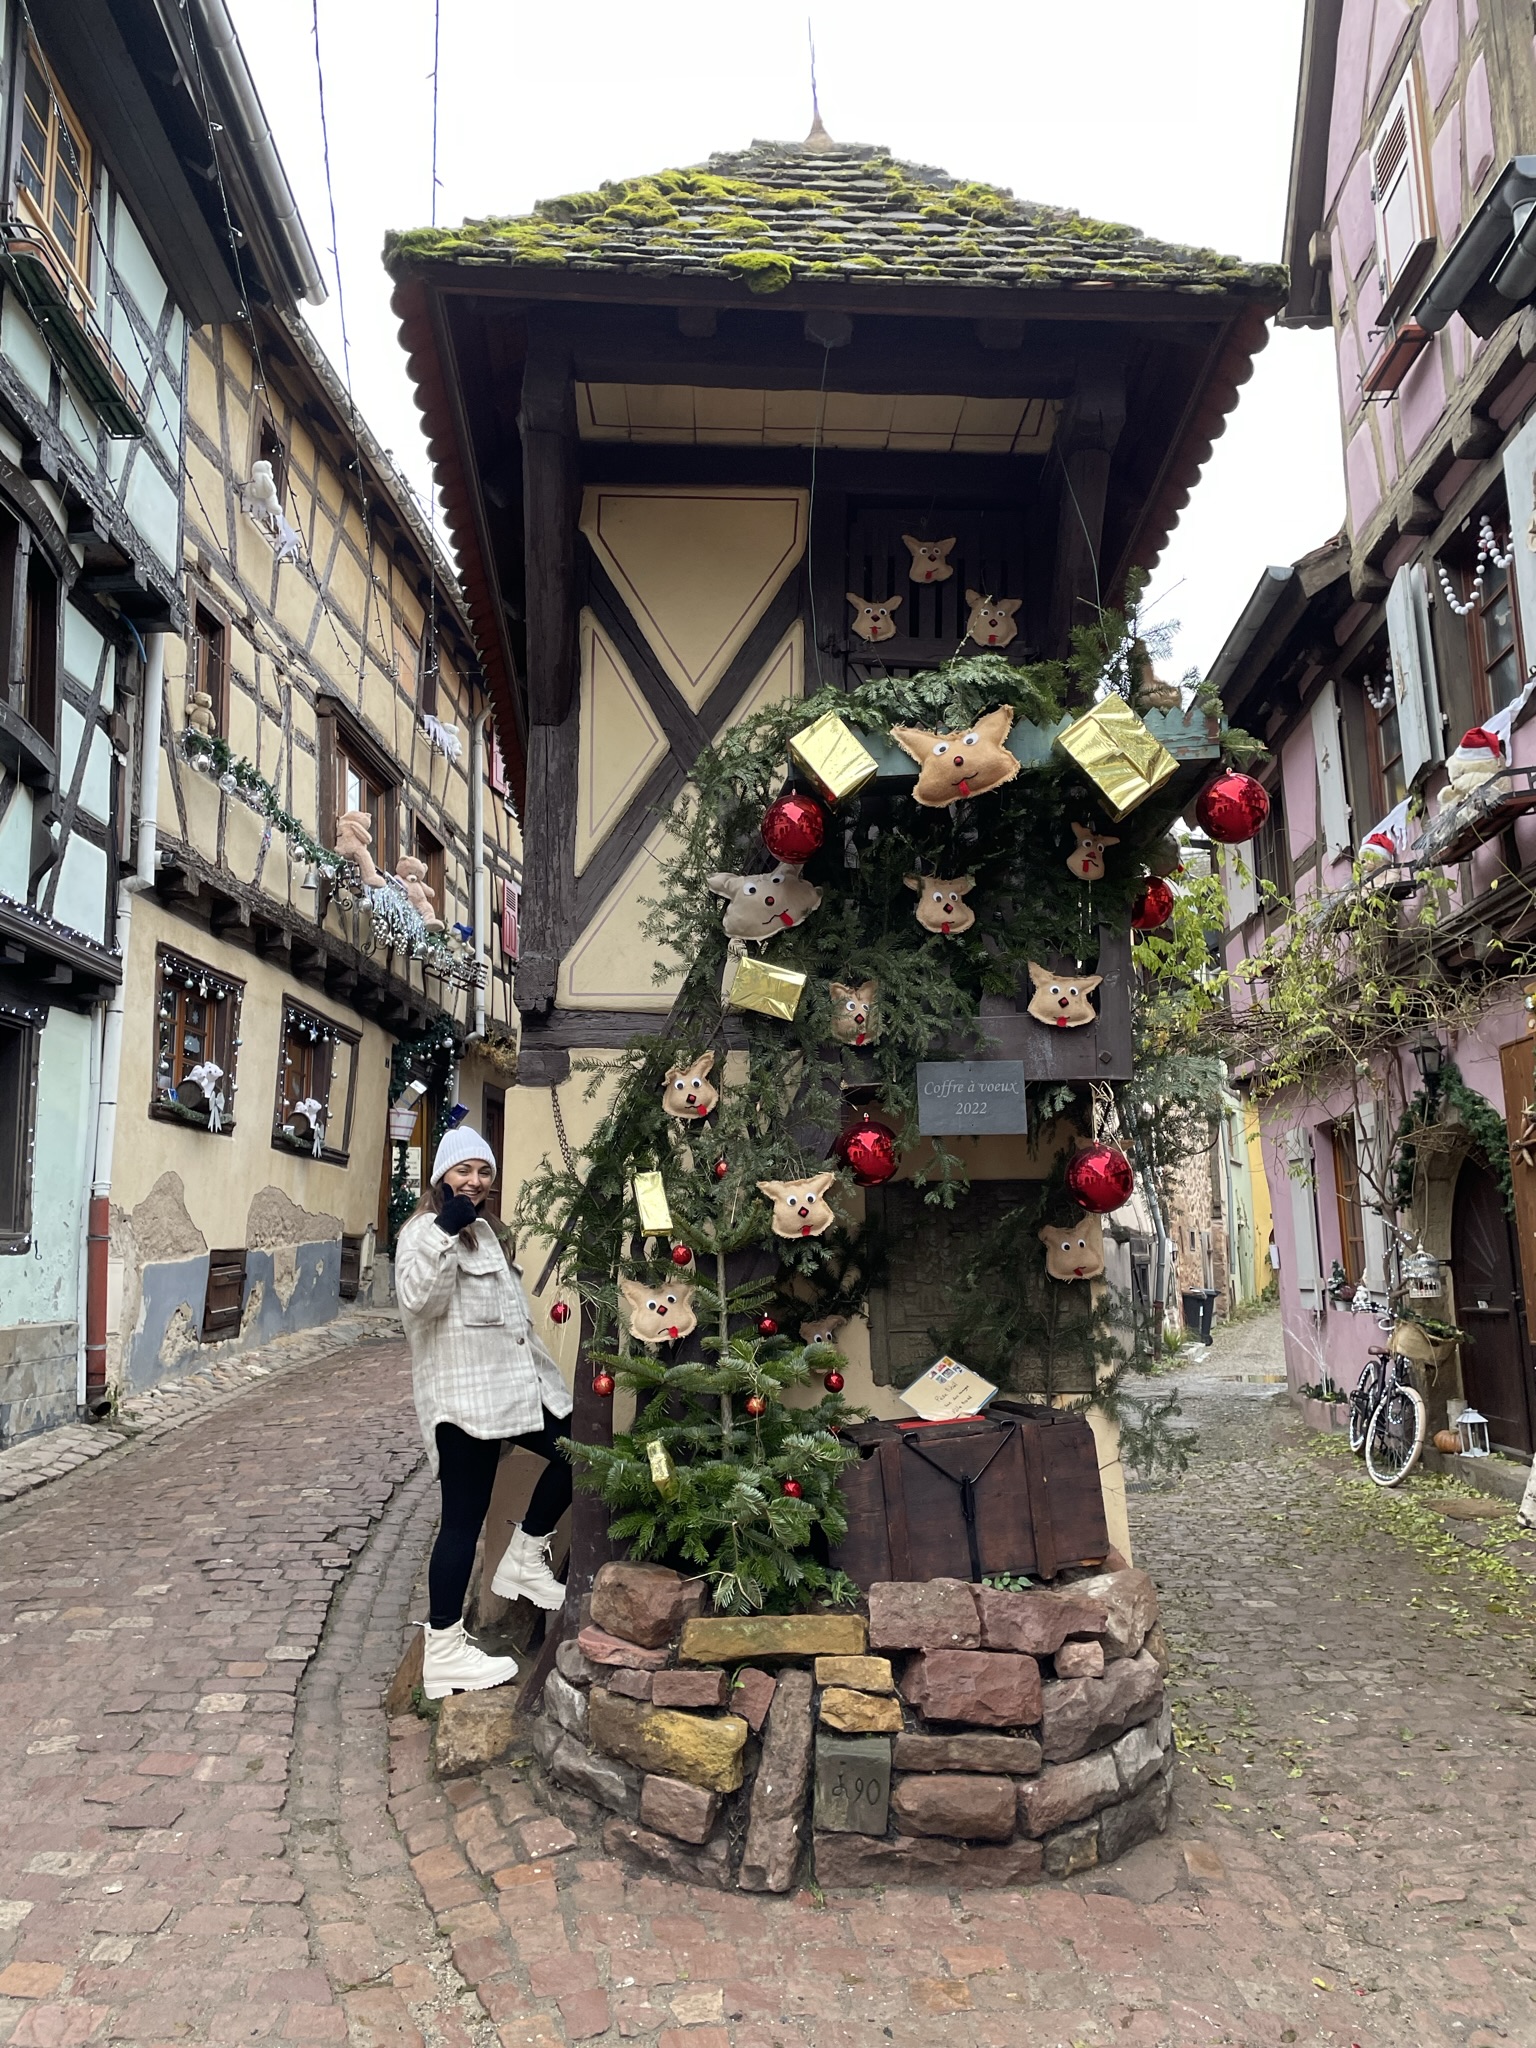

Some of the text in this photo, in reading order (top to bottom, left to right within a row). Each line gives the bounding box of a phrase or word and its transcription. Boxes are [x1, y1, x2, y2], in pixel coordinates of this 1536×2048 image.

[924, 1080, 1019, 1098] Coffre à voeux
[955, 1102, 987, 1115] 2022
